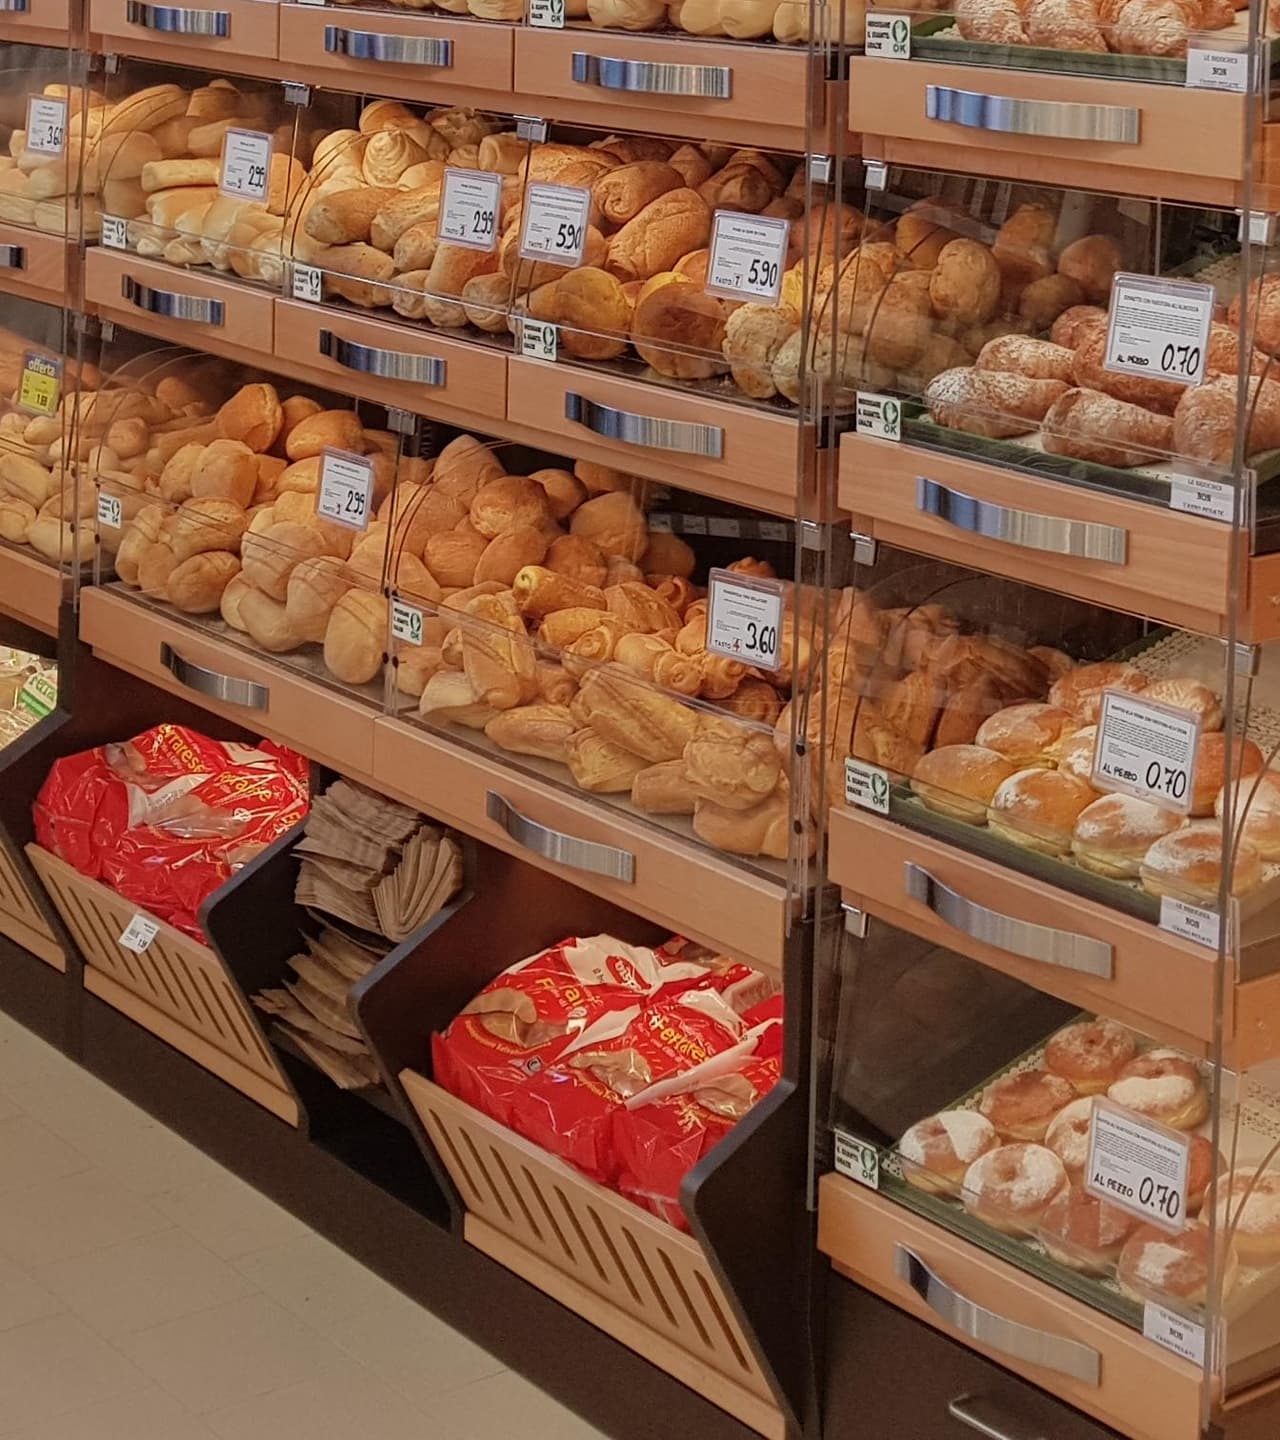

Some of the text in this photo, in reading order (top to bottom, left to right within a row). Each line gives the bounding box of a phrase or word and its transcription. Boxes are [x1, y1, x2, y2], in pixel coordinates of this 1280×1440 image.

[893, 43, 906, 54] OK
[748, 259, 778, 289] 5.90
[28, 358, 56, 377] offerta
[1161, 343, 1200, 376] 0.70
[884, 423, 897, 435] OK
[745, 622, 776, 655] 3.60
[158, 723, 206, 773] errarese
[1102, 762, 1111, 774] AL
[1145, 761, 1187, 798] 0.70
[873, 796, 886, 808] OK
[1094, 1173, 1134, 1198] AL PEZZO
[1139, 1176, 1181, 1219] 0.70
